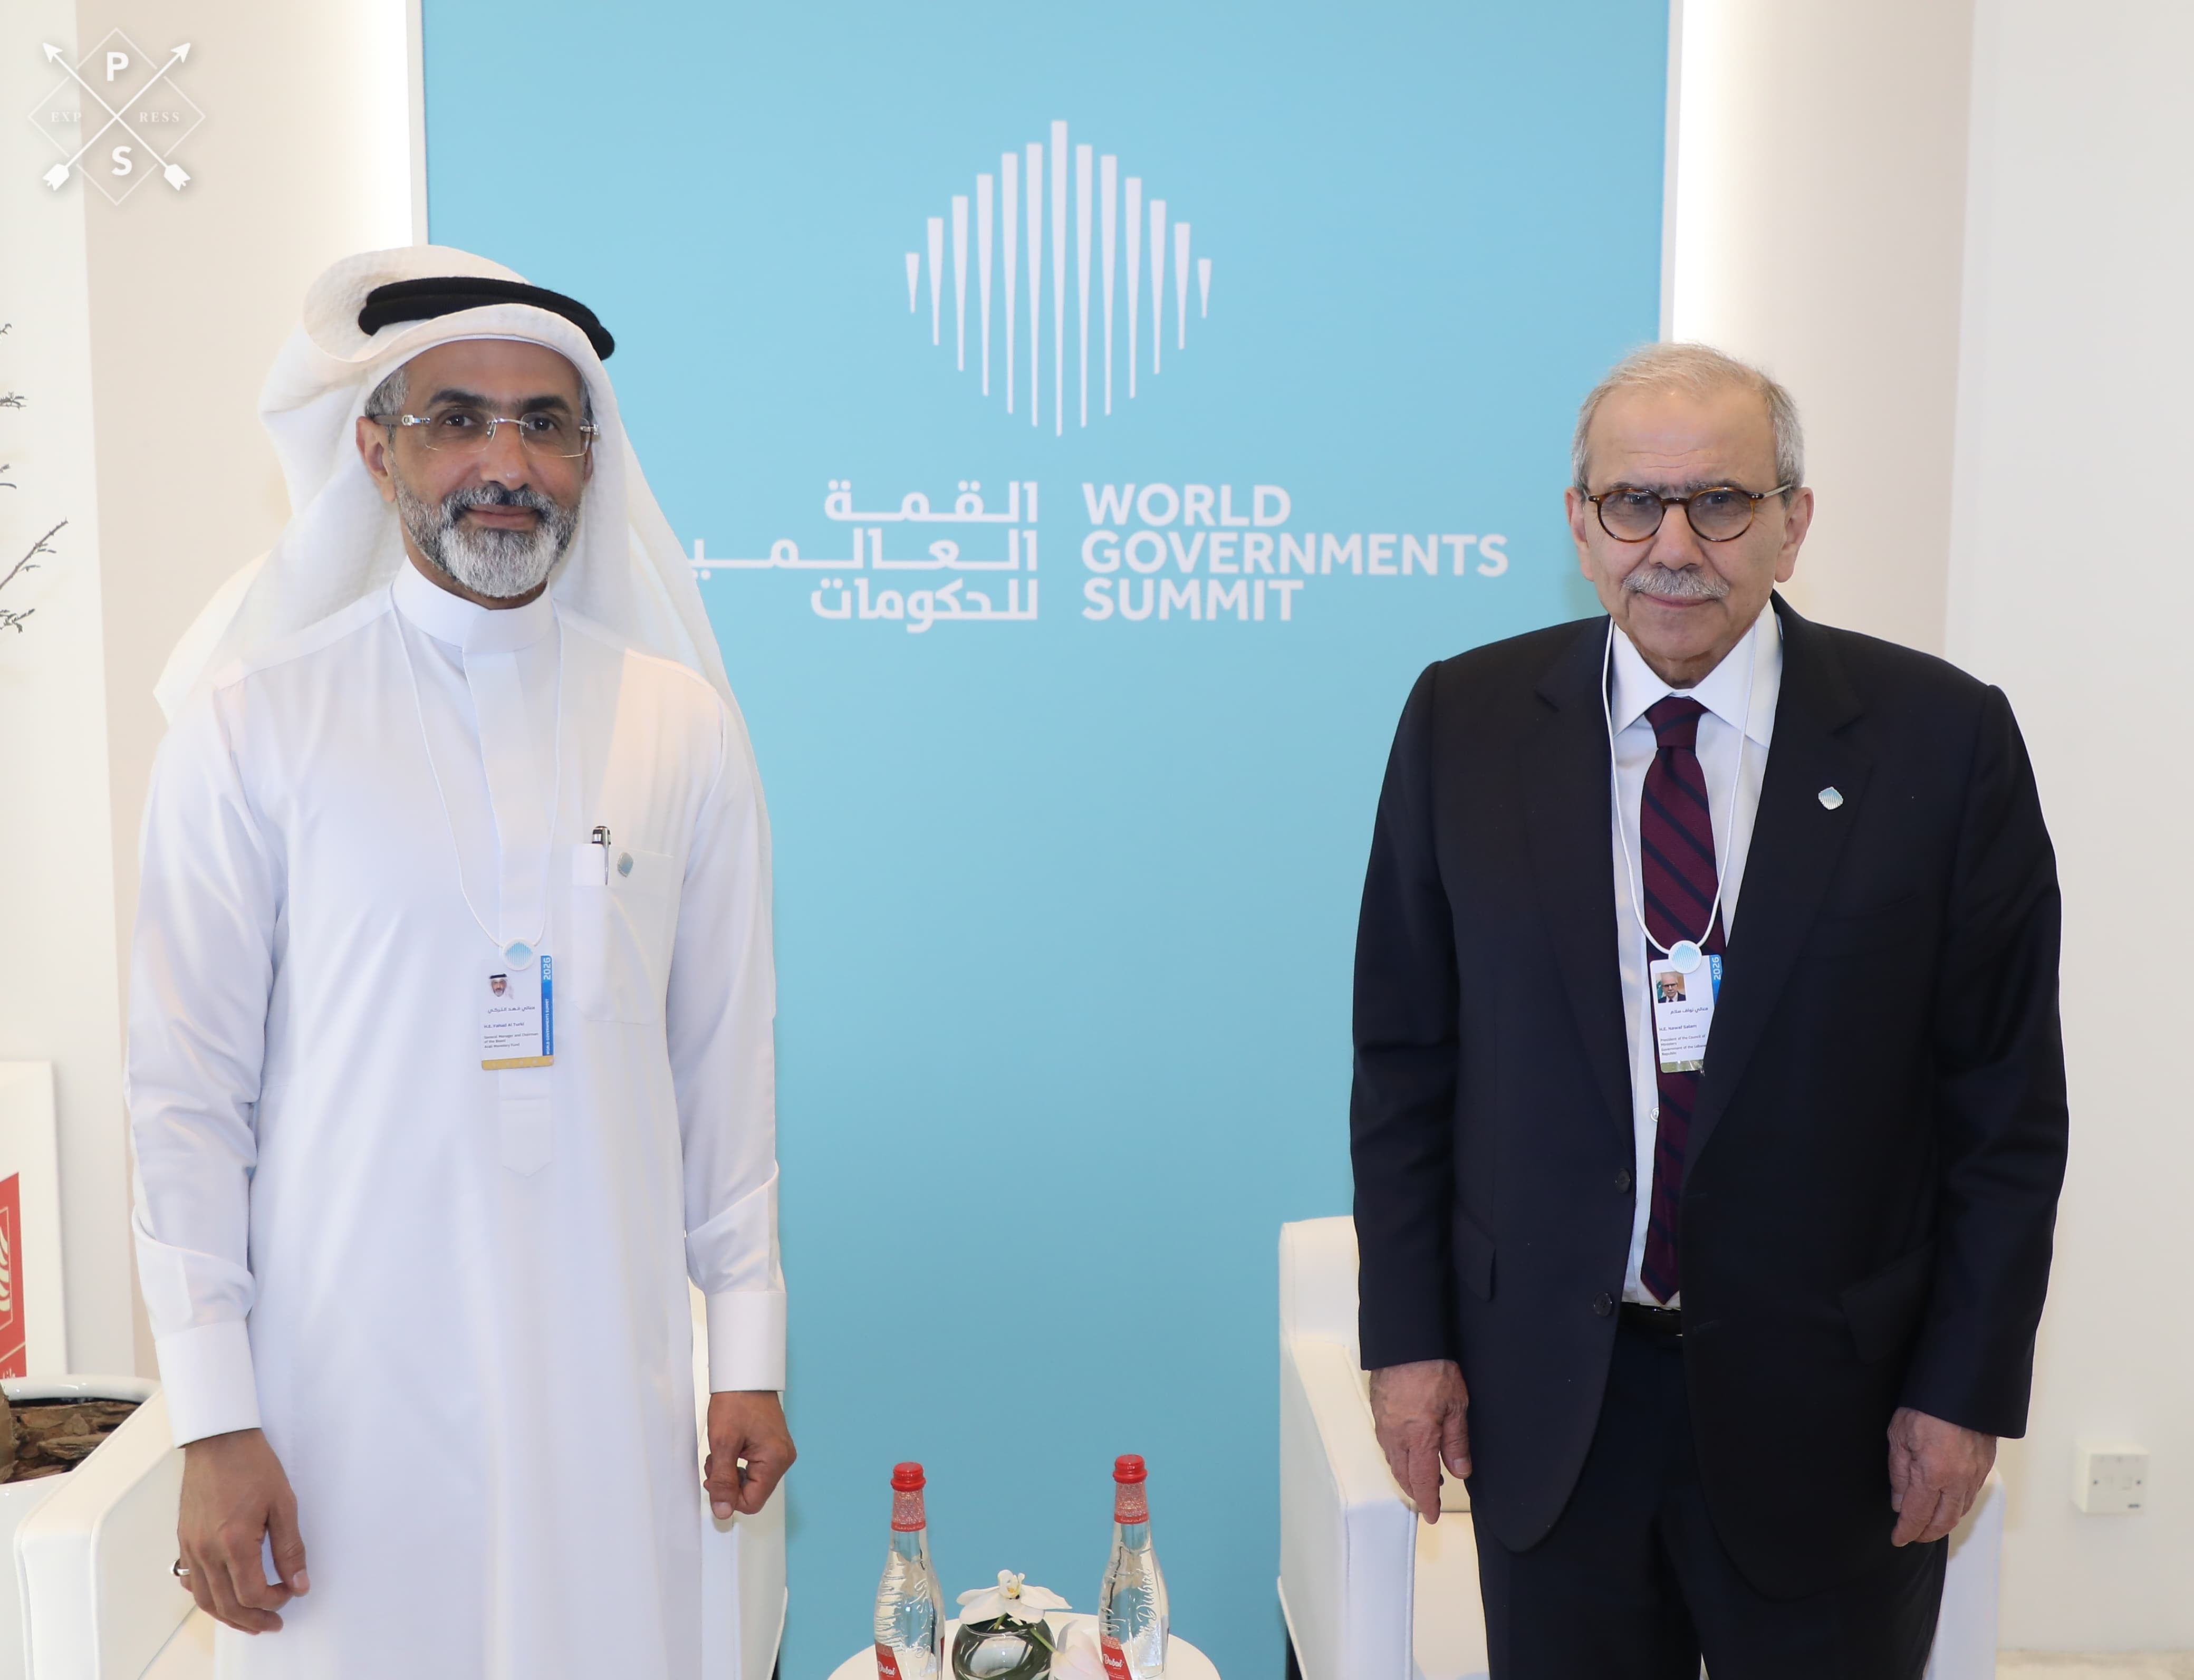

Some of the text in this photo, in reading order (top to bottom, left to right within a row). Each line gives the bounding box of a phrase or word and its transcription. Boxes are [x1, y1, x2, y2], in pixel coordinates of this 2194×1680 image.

[824, 479, 1037, 523] القمة
[1082, 483, 1291, 526] WORLD
[687, 527, 1037, 580] العالمي
[1082, 530, 1509, 577] GOVERNMENTS
[811, 578, 1037, 633] للحكومات
[1082, 578, 1304, 621] SUMMIT
[1712, 957, 1721, 980] 2026
[878, 1660, 896, 1676] Dubai
[1103, 1654, 1122, 1668] Dubai
